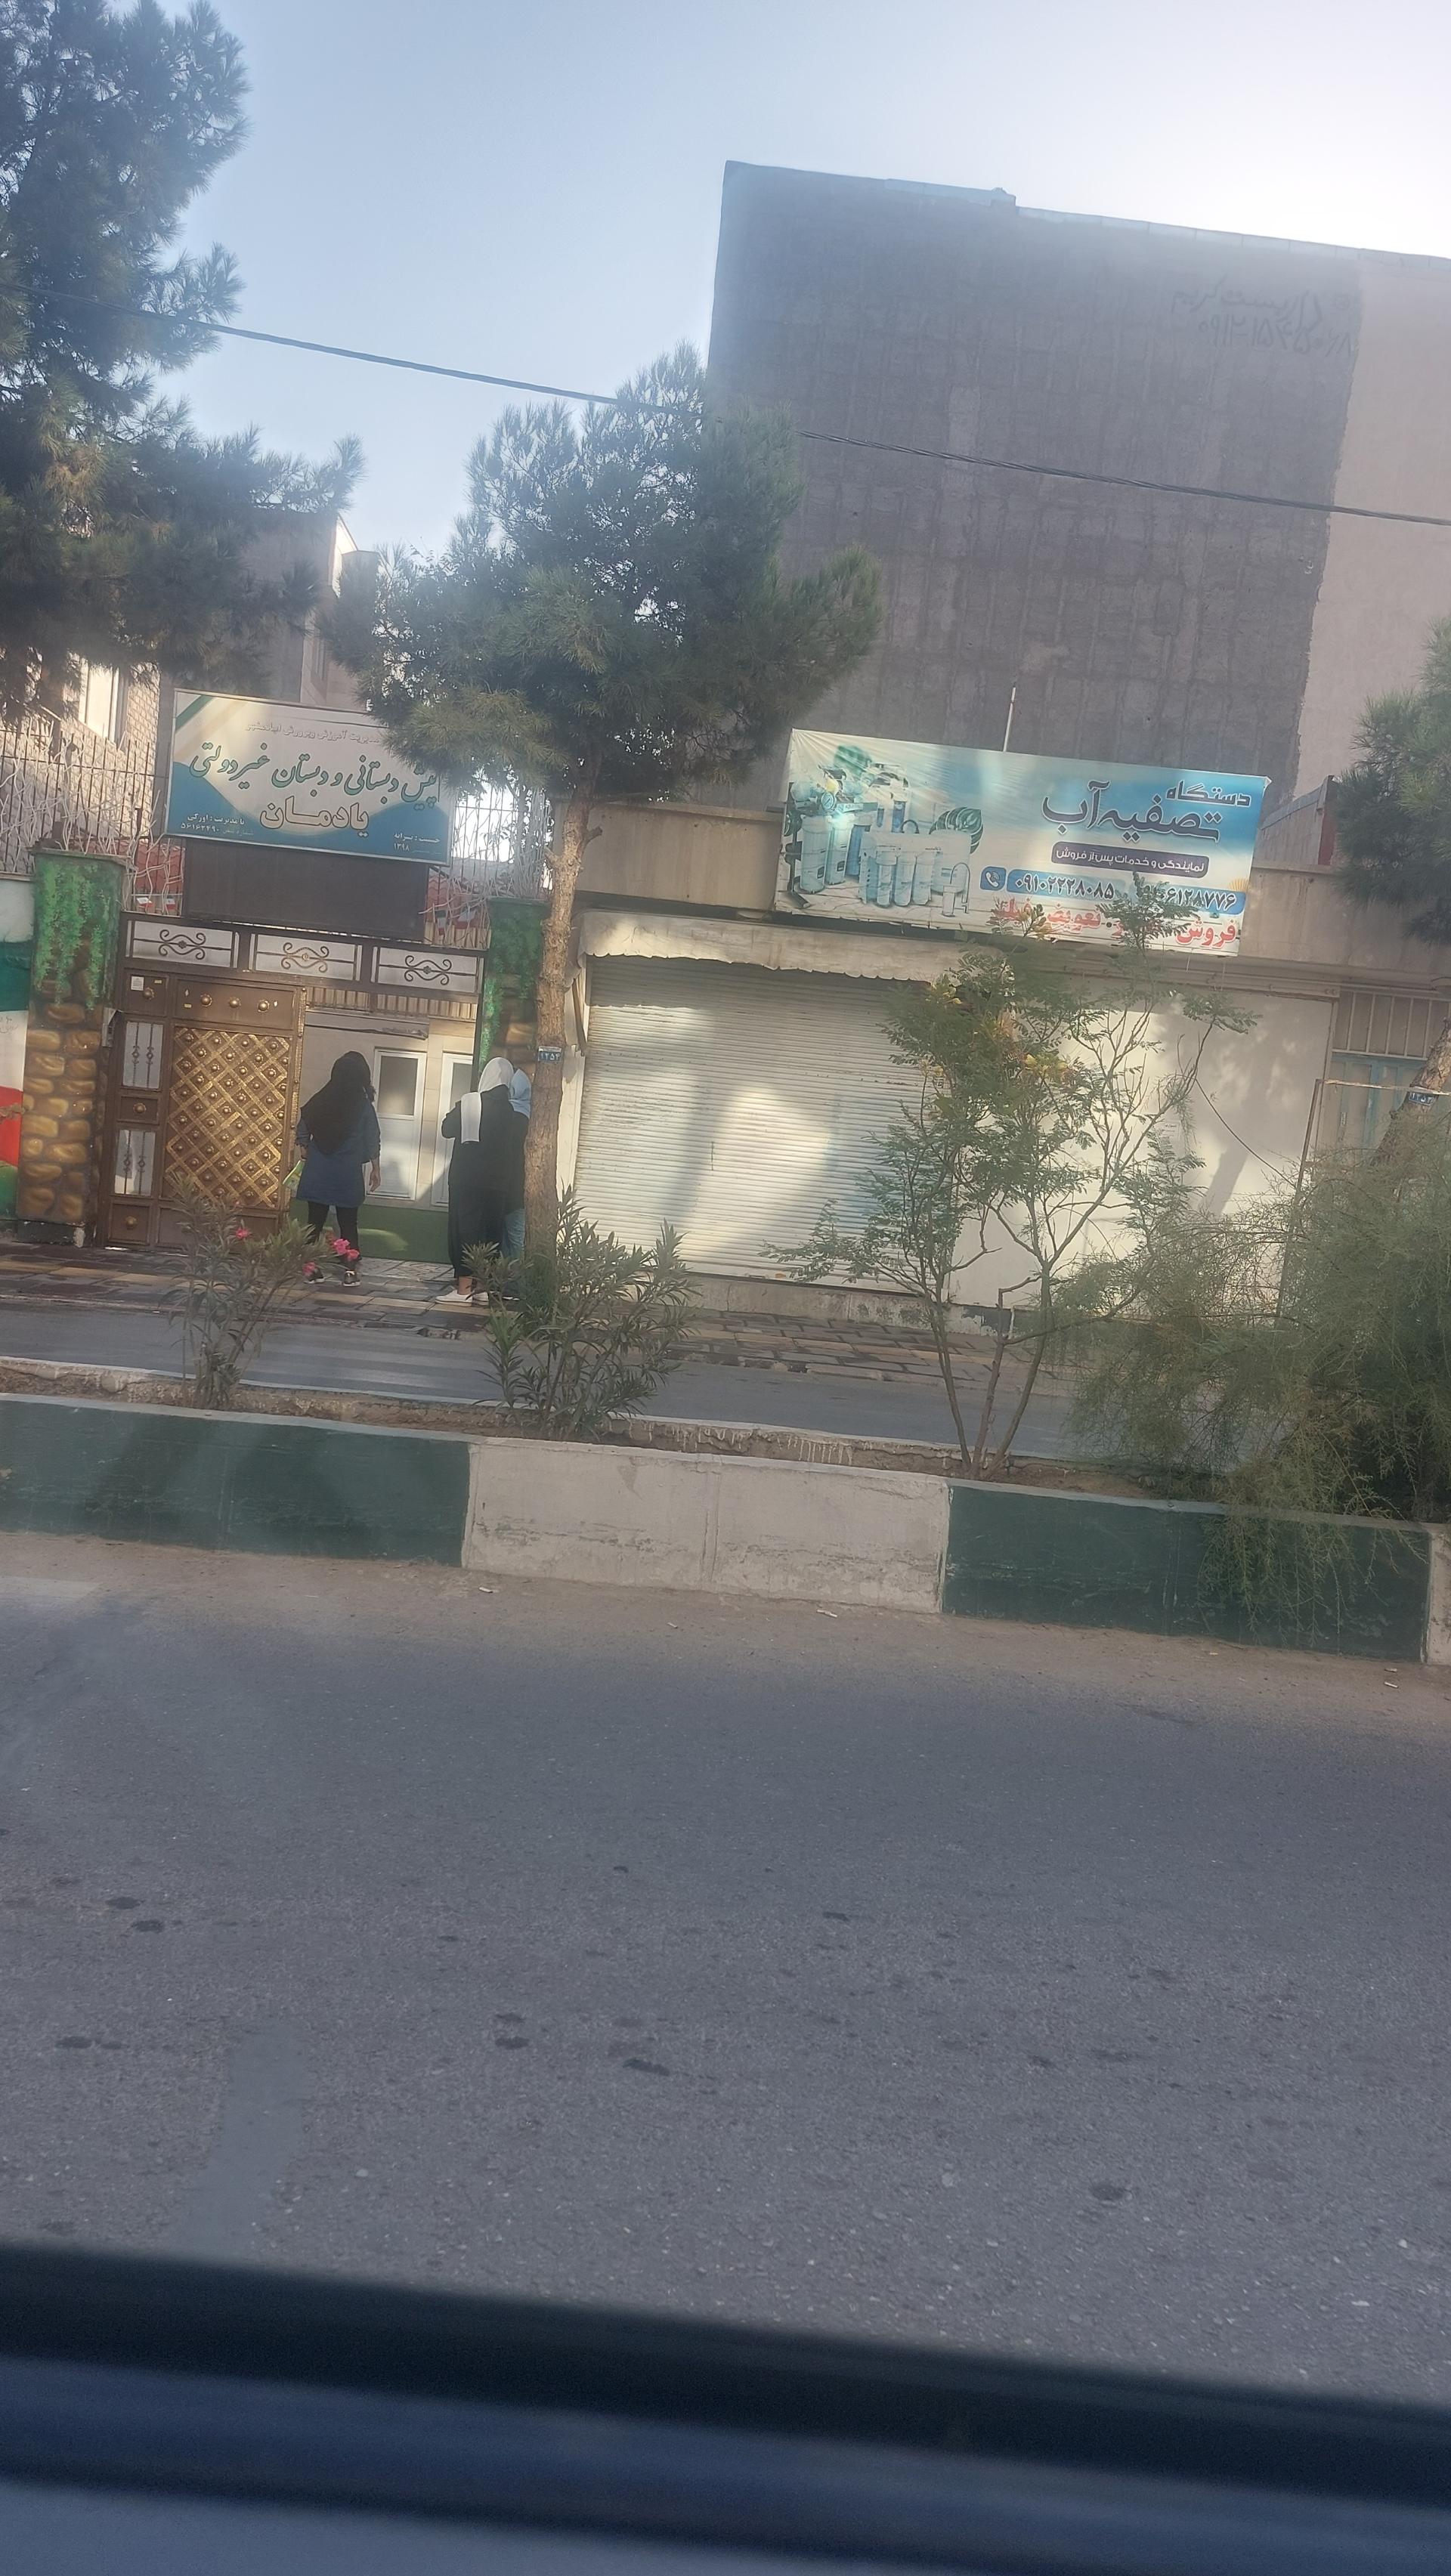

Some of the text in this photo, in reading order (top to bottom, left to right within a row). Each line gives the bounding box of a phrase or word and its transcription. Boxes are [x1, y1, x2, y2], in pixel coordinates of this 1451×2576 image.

[271, 753, 329, 798] دبستان
[329, 772, 344, 787] و
[344, 754, 400, 805] دبستانی
[1165, 779, 1252, 807] دستگاه
[259, 795, 370, 838] یادمان
[1041, 779, 1224, 843] تصفیه آب
[1055, 846, 1205, 873] نمایندگی و خدمات پس از فروش
[1175, 918, 1237, 948] فروش
